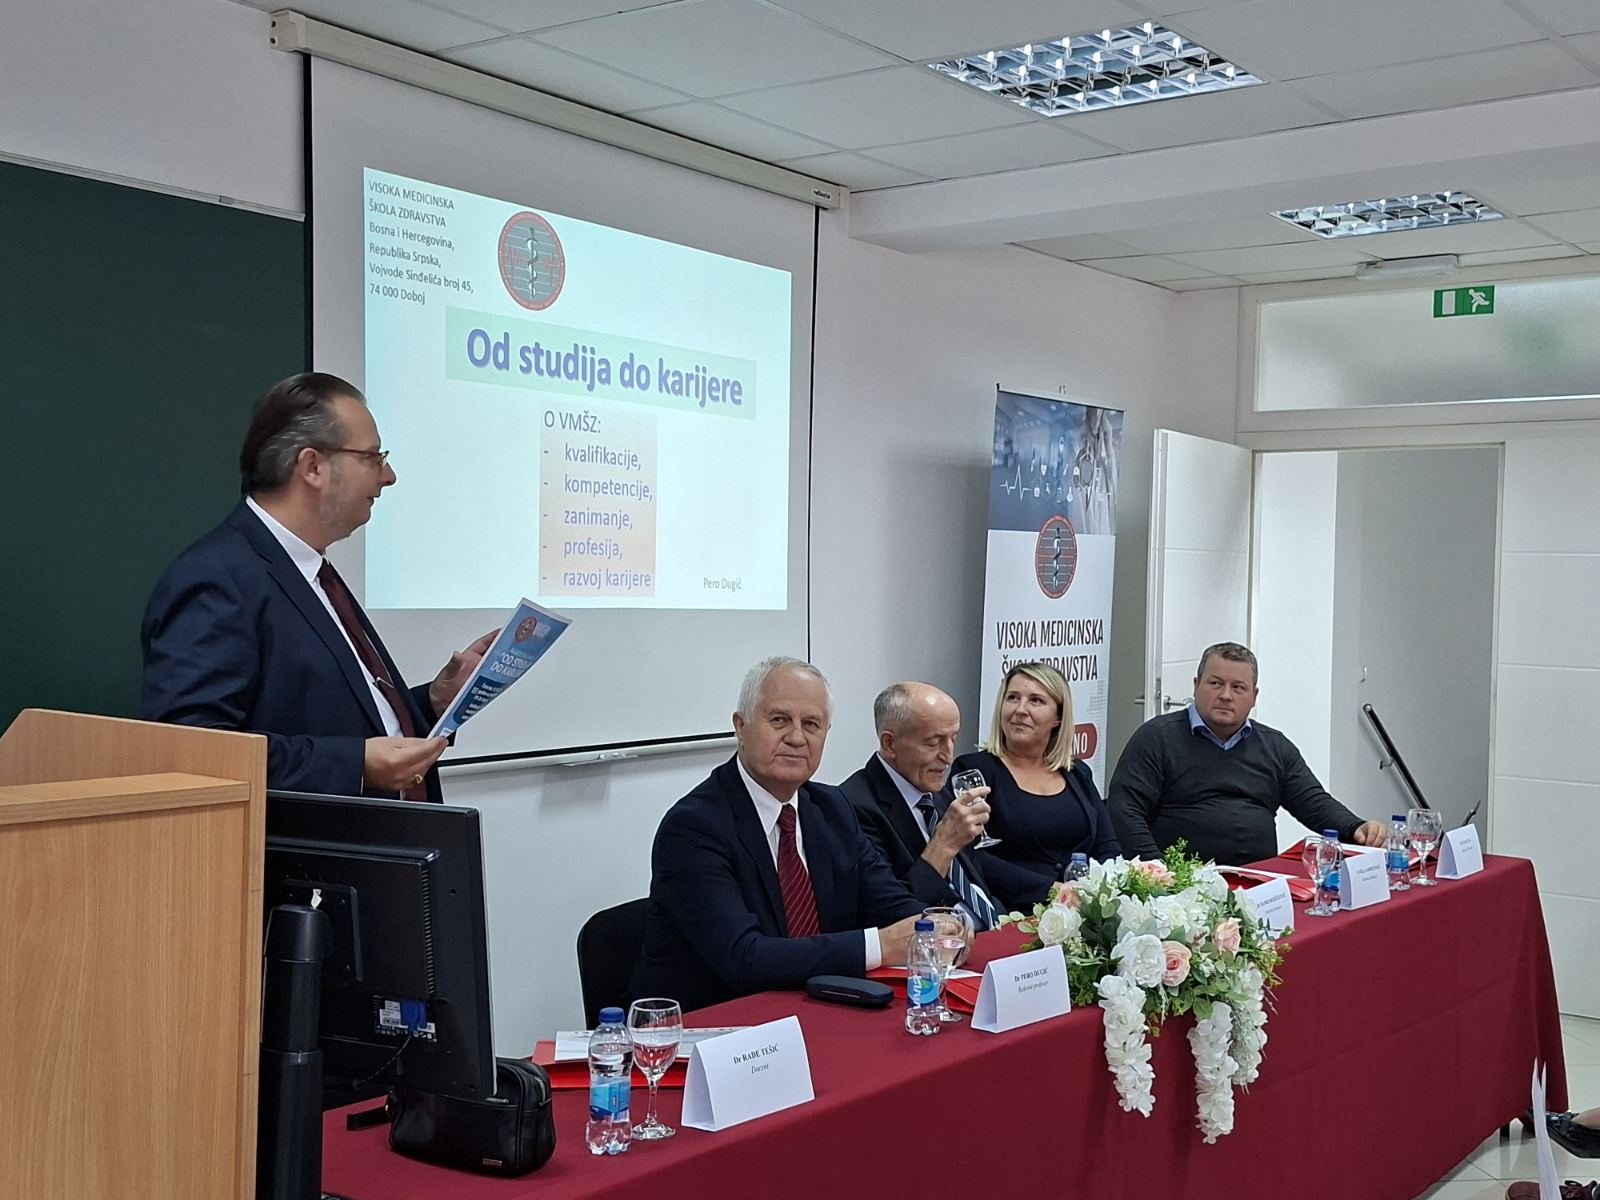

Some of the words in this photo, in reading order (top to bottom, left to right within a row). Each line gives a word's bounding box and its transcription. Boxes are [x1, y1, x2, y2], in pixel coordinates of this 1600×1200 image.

[369, 180, 400, 198] VISOKA
[403, 188, 454, 210] MEDICINSKA
[369, 198, 396, 217] ŠKOLA
[398, 206, 446, 227] ZDRAVSTVA
[369, 222, 396, 237] Bosna
[402, 228, 455, 251] Hercegovina,
[369, 242, 411, 261] Republika
[413, 251, 441, 268] Srpska,
[369, 263, 404, 280] Vojvode
[444, 275, 460, 291] broj
[461, 280, 474, 294] 45,
[370, 283, 380, 296] 74
[382, 285, 399, 298] 000
[401, 288, 425, 305] Doboj
[467, 328, 510, 371] Od
[519, 341, 611, 392] studija
[619, 352, 651, 391] do
[658, 357, 743, 408] karijere
[544, 410, 555, 428] O
[559, 410, 601, 434] VMŠZ:
[565, 443, 642, 471] kvalifikacije,
[564, 474, 653, 502] kompetencije,
[564, 507, 633, 530] zanimanje,
[563, 537, 623, 560] profesija,
[563, 569, 602, 590] razvoj
[606, 568, 651, 590] karijere
[703, 578, 720, 590] Pero
[721, 578, 742, 592] Dugić
[997, 621, 1037, 650] VISOKA
[1040, 619, 1104, 648] MEDICINSKA
[1040, 655, 1098, 681] AVSTVA
[733, 1055, 742, 1065] Dr
[742, 1050, 761, 1062] RADE
[761, 1043, 779, 1056] TEŠIĆ
[751, 1063, 769, 1074] Docent
